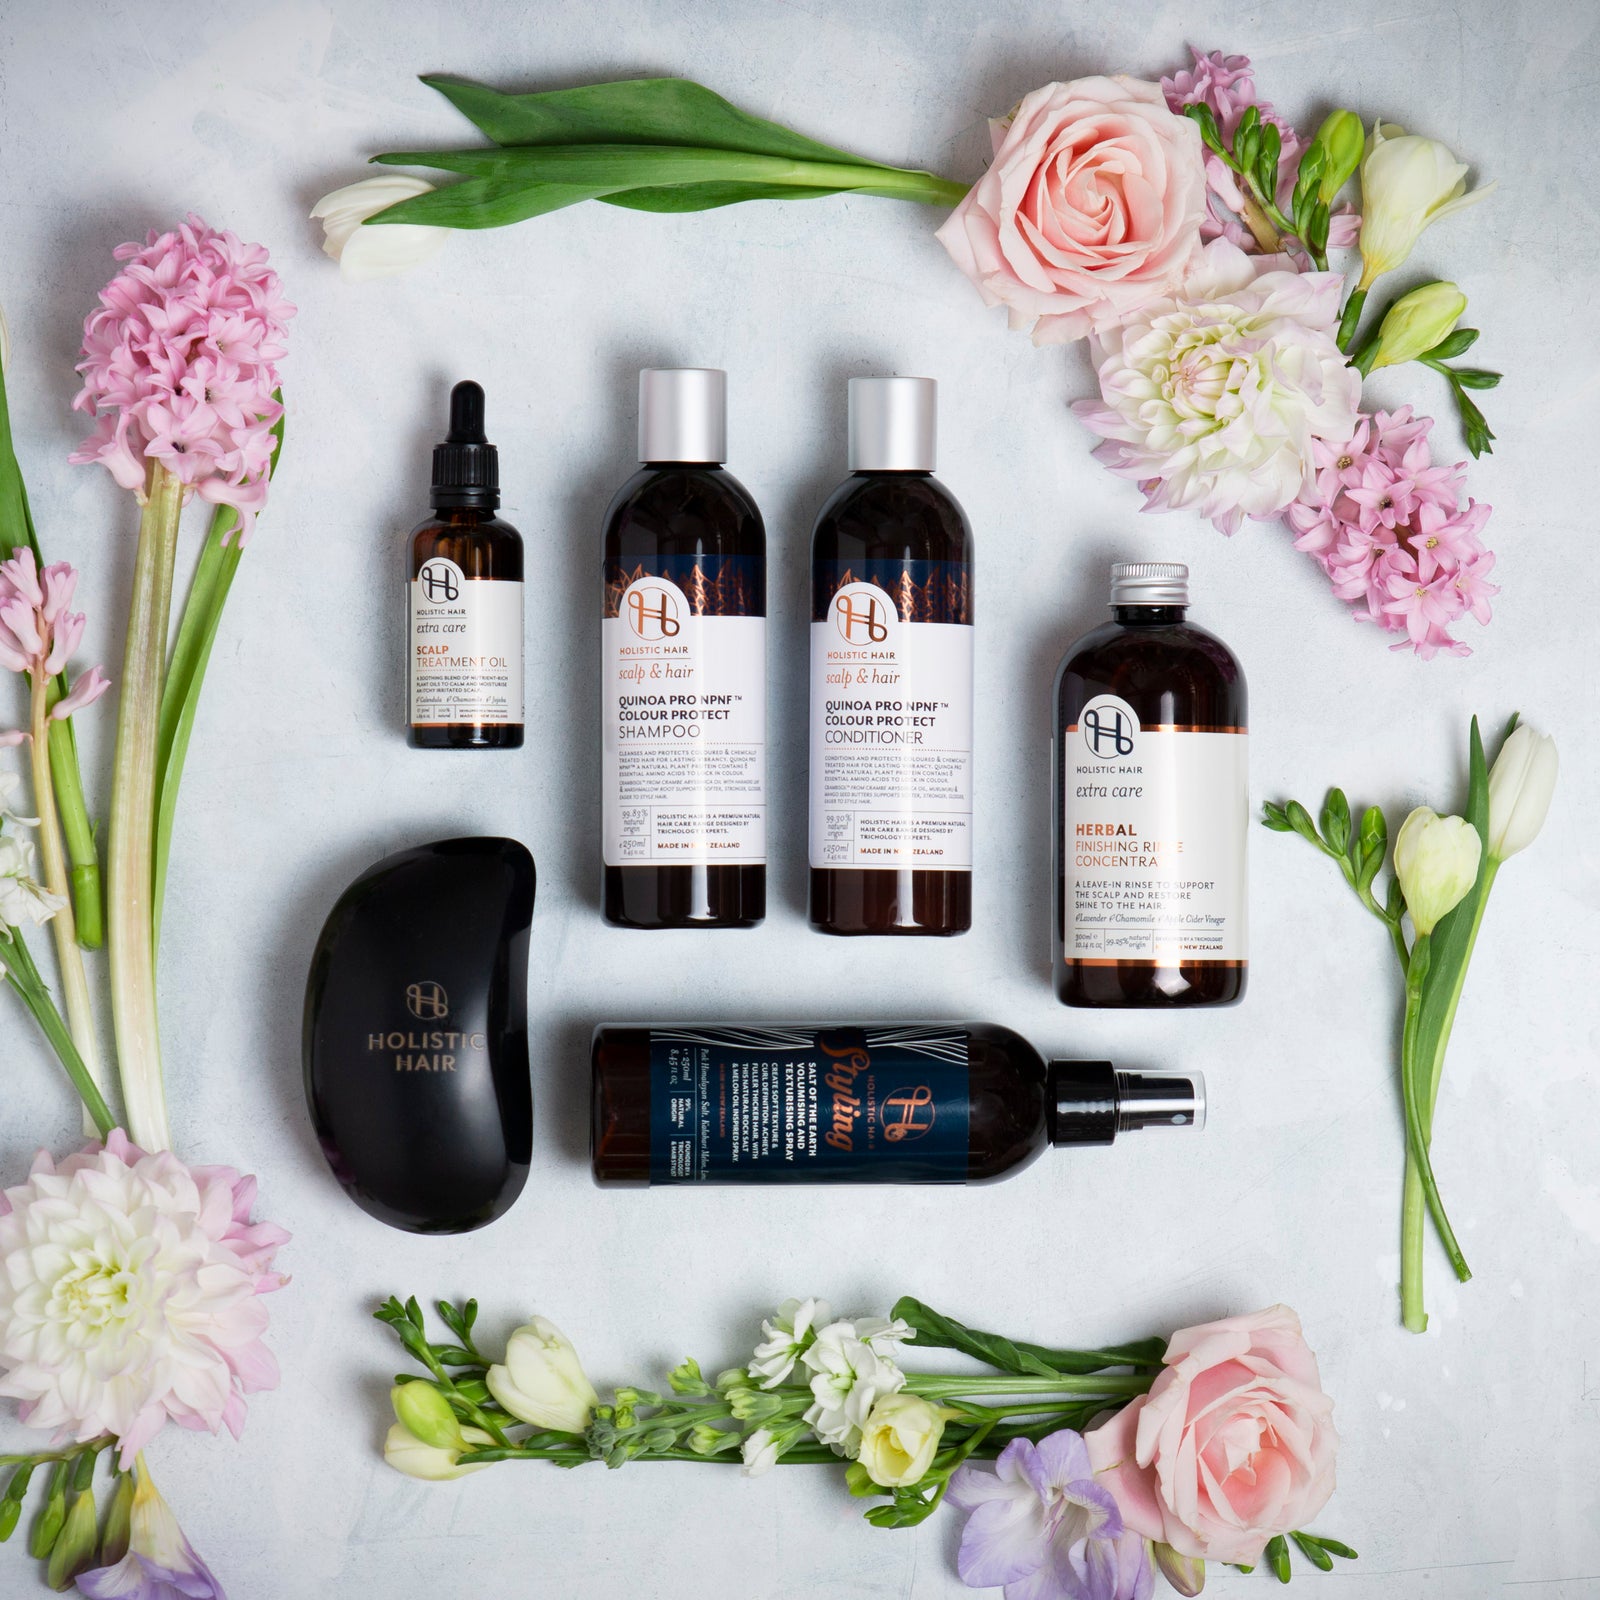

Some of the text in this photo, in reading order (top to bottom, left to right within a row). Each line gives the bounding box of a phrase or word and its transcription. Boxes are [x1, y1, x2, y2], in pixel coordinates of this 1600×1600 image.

[417, 622, 466, 633] extra care
[416, 646, 448, 654] SCALP
[620, 647, 660, 655] HOLISTIC
[416, 657, 507, 667] TREATMENT OIL
[619, 663, 694, 684] scalp & hair
[826, 668, 900, 688] scalp & hair
[619, 695, 666, 709] QUINOA
[670, 695, 696, 705] PRO
[826, 700, 872, 714] QUINOA
[875, 701, 902, 710] PRO
[619, 710, 730, 720] COLOUR PROTECT
[826, 716, 936, 726] COLOUR PROTECT
[619, 725, 700, 738] SHAMPOO
[826, 730, 923, 744] CONDITIONER
[1077, 783, 1142, 797] extra care
[1076, 824, 1137, 836] HERBAL
[1076, 842, 1184, 852] FINISHING RIE
[1081, 913, 1225, 926] Lavender Chamomile Cider Vinegar
[368, 1032, 485, 1050] HOLISTIC
[668, 1049, 678, 1066] 8.45
[701, 1048, 709, 1061] Pink
[395, 1054, 456, 1072] HAIR
[682, 1057, 691, 1080] 250ml
[698, 1062, 709, 1099] Himalayan
[809, 1087, 816, 1101] OF
[820, 1039, 870, 1152] Styling
[797, 1062, 805, 1149] VOLUMISING AND
